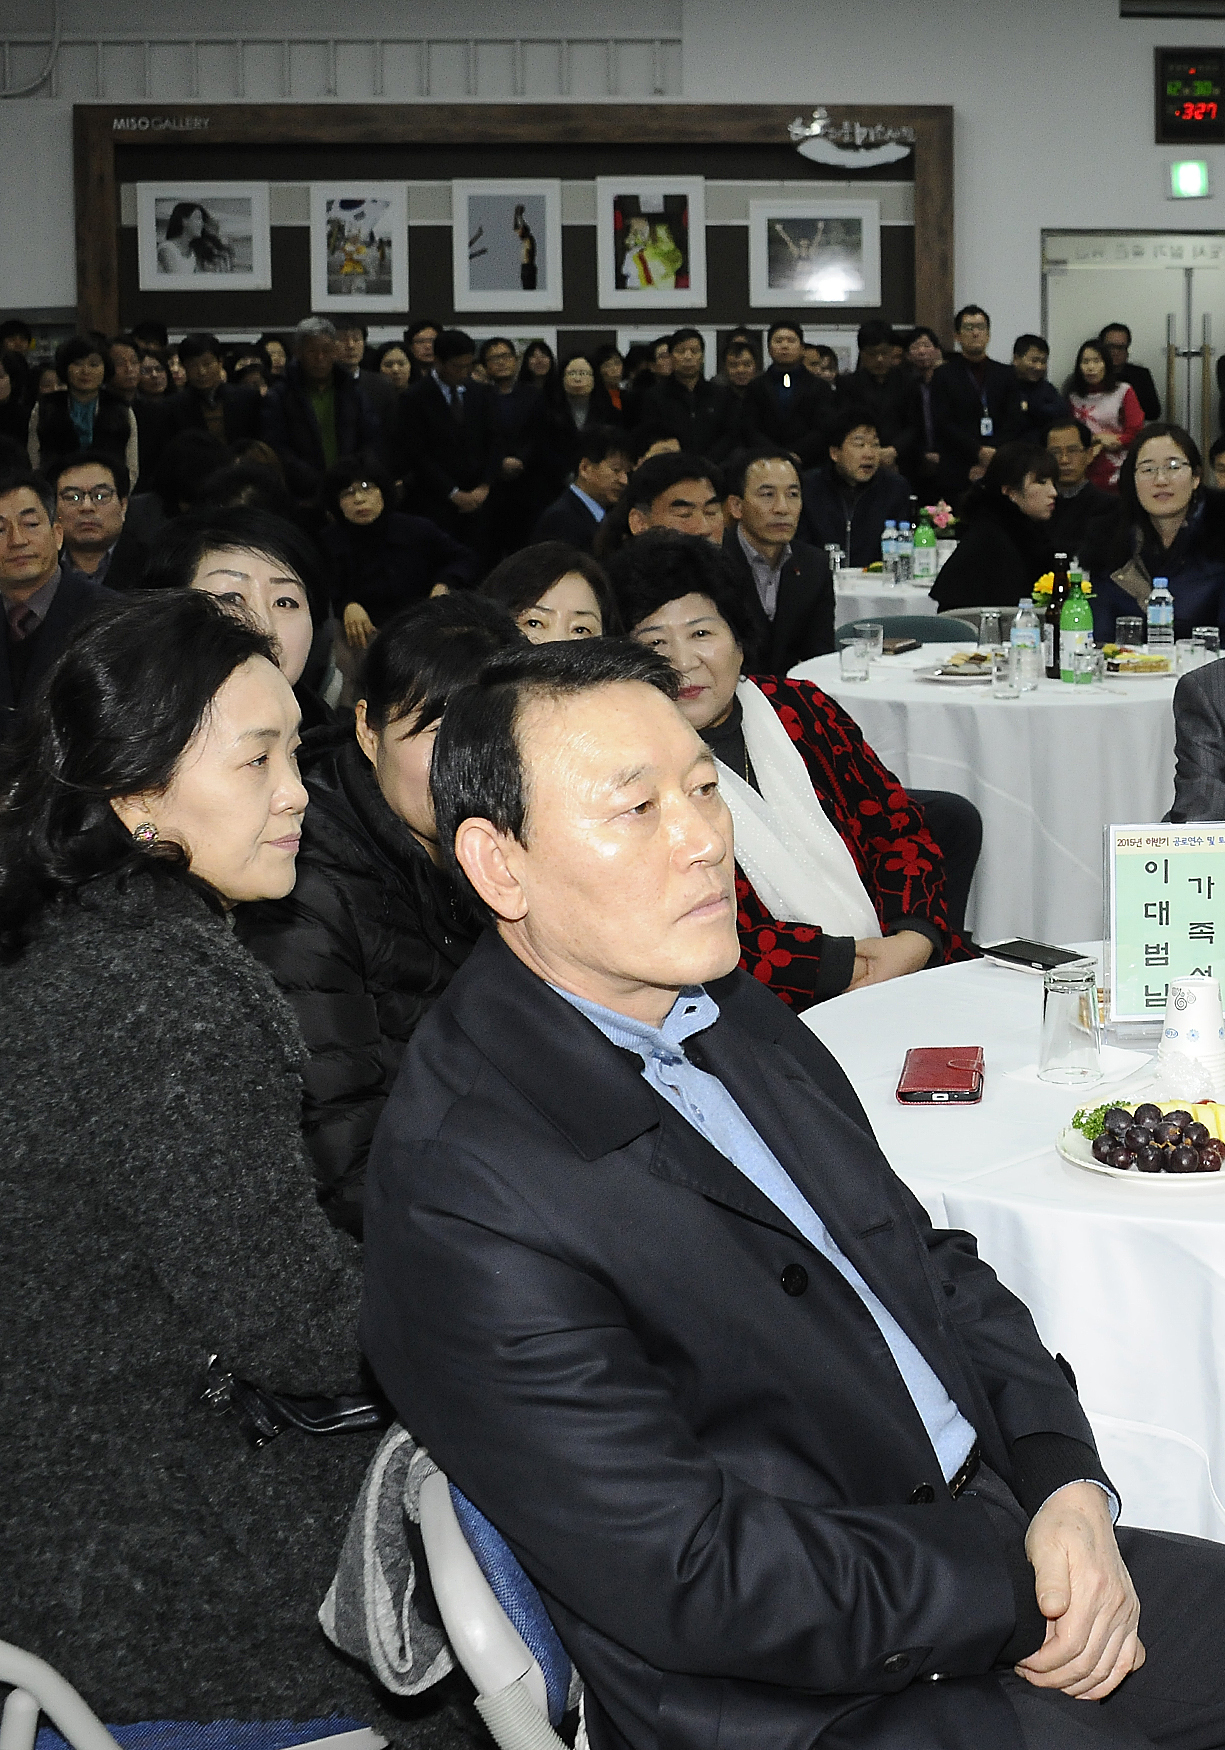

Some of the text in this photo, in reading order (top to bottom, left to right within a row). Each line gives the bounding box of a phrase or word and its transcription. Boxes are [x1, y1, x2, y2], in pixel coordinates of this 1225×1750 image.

[1116, 838, 1143, 848] 2015년
[1145, 836, 1169, 848] 하반기
[1172, 836, 1204, 847] 공로연수
[1206, 835, 1215, 846] 및
[1144, 858, 1170, 1008] 이대범님
